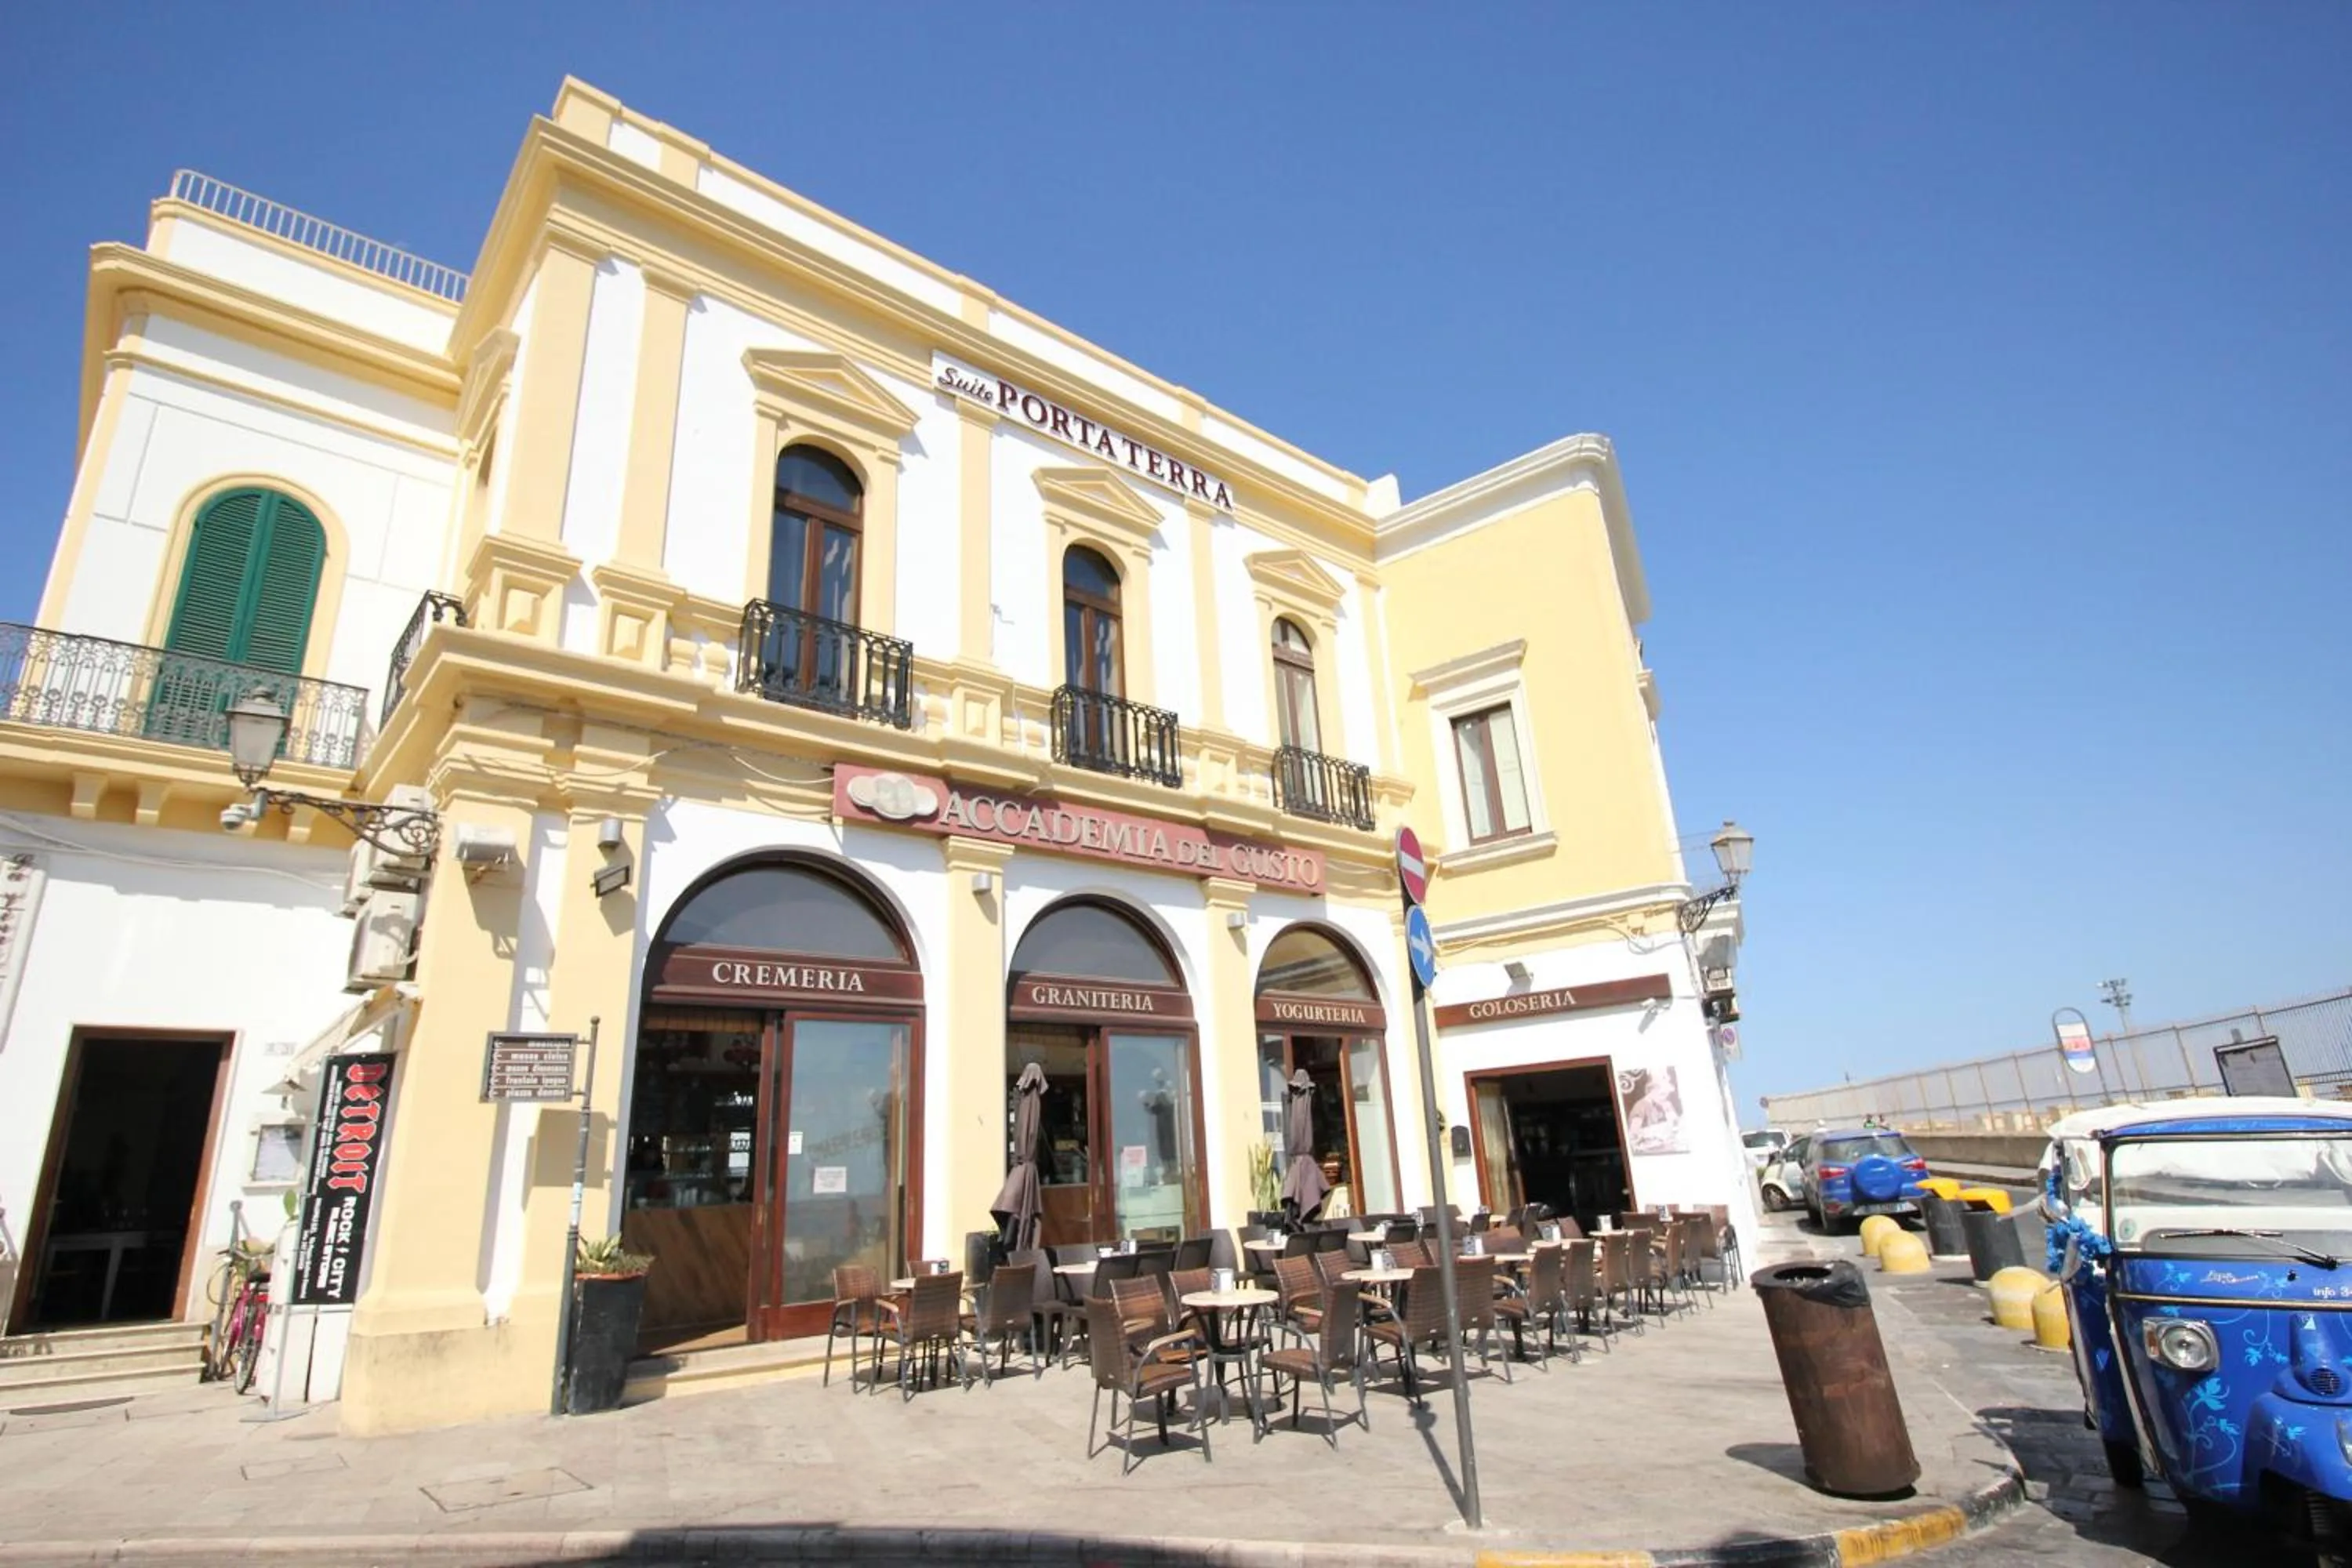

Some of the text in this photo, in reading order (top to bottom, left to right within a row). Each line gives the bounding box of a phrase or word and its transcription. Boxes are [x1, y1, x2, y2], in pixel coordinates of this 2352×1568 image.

[938, 366, 1234, 510] Suite PORTA TERRA
[938, 789, 1319, 887] ACCADEMIA DEL GUSTO
[712, 962, 864, 992] CREMERIA
[1031, 985, 1154, 1011] GRANITERIA
[1469, 990, 1577, 1018] GOLOSERIA
[1273, 1003, 1366, 1022] YOGURTERIA
[327, 1063, 387, 1193] DETROIT
[327, 1196, 358, 1298] ROCK CITY
